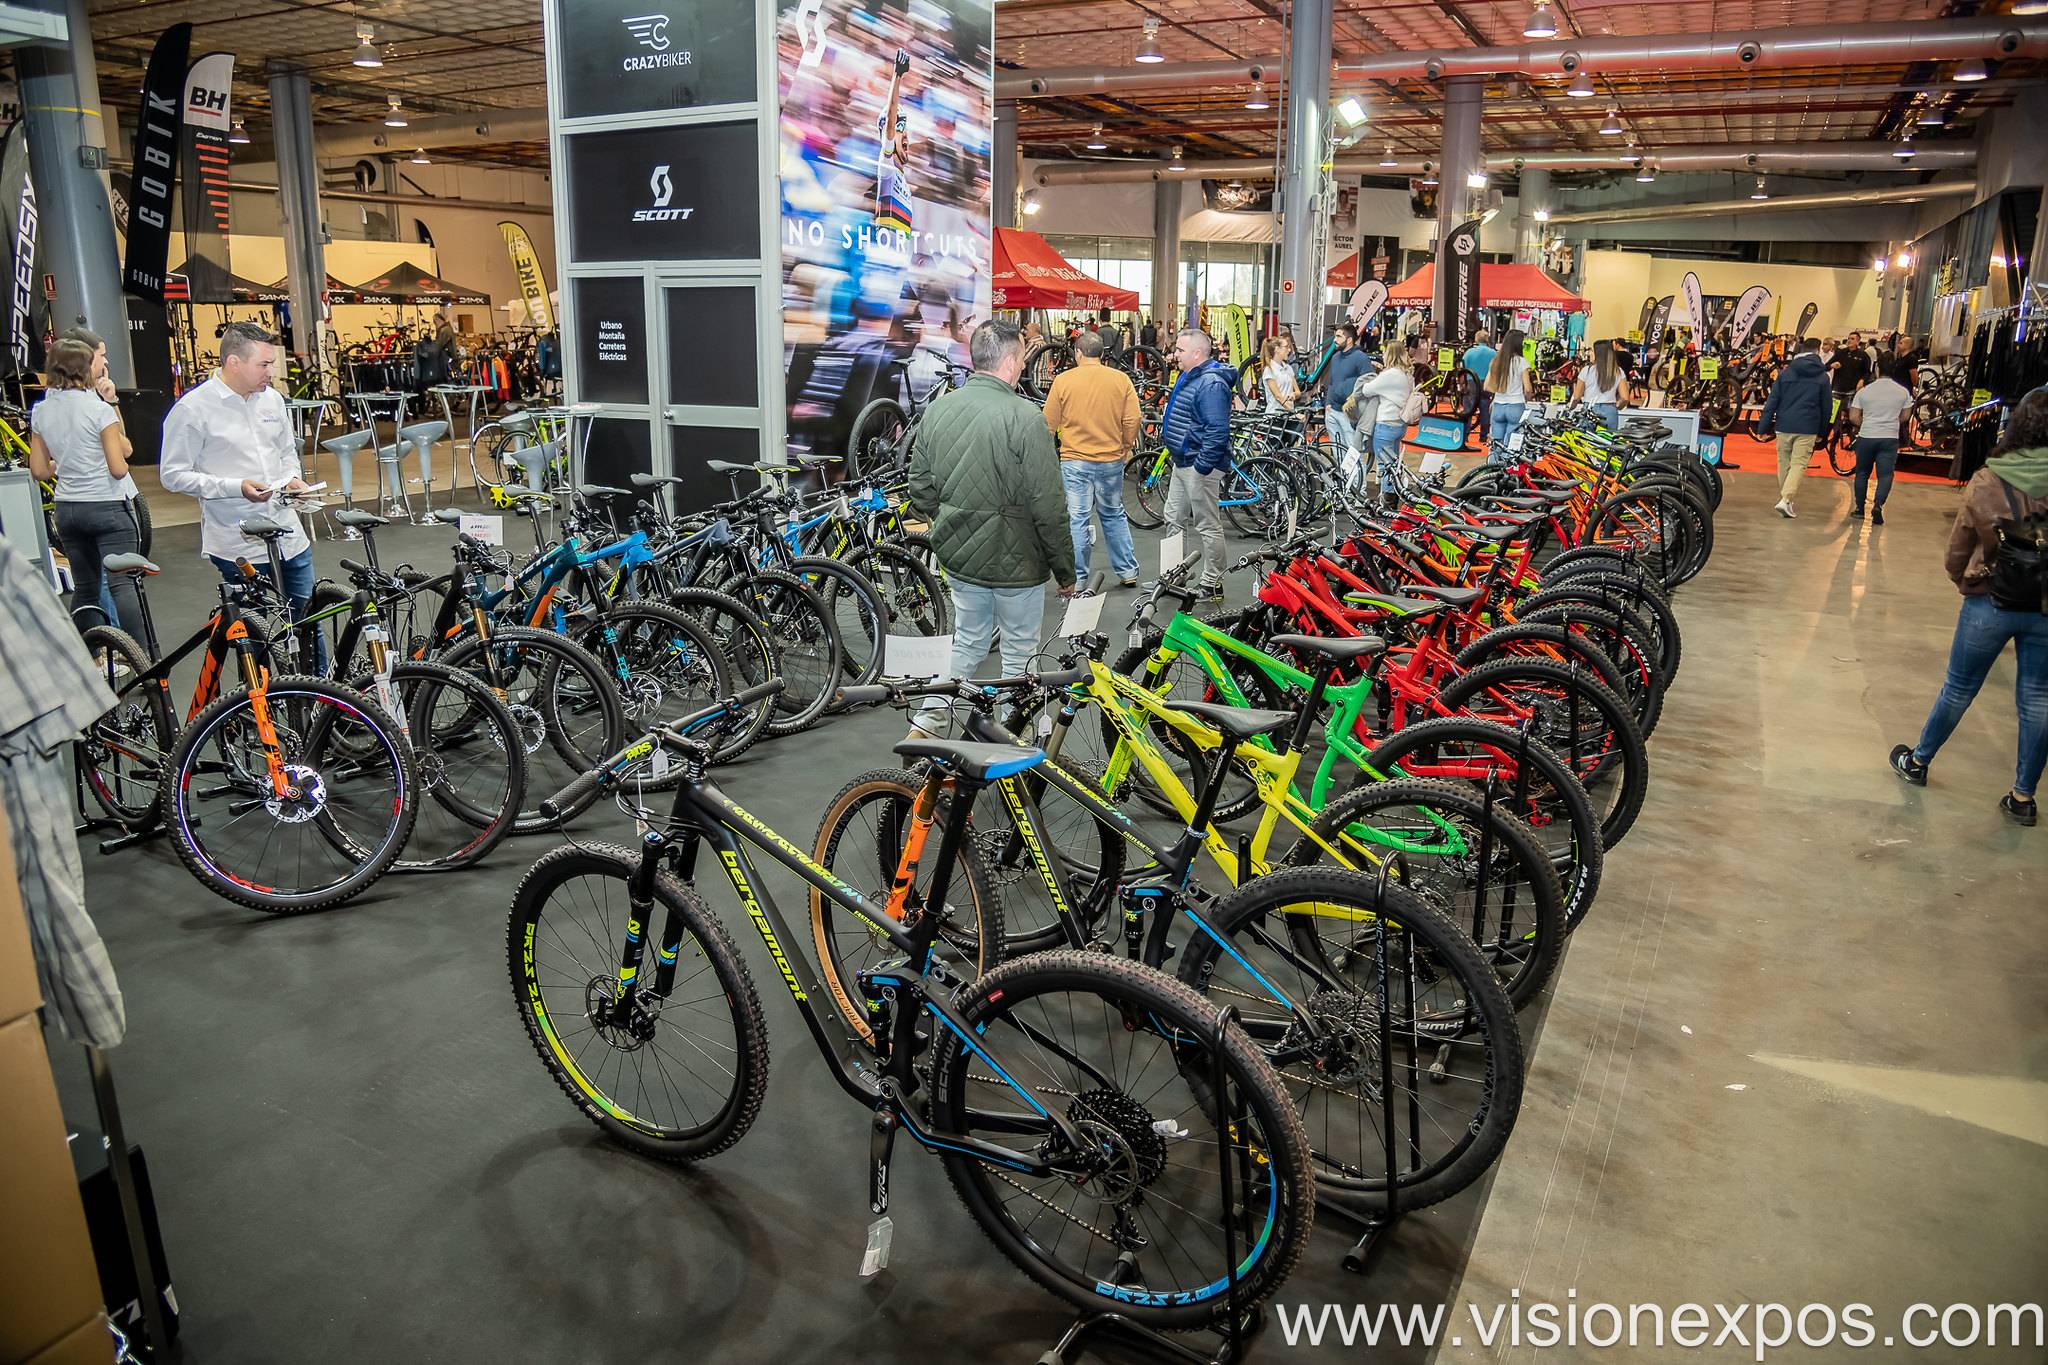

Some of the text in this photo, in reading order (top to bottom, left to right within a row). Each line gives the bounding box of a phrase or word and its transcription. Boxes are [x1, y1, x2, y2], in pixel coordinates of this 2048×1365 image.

[624, 51, 692, 71] CRAZYBIKER
[189, 86, 228, 111] BH
[138, 90, 177, 229] GOBIK
[632, 207, 694, 222] SCOTT
[788, 218, 978, 258] NO SHORTCUTS
[132, 268, 160, 291] GOBIK
[363, 296, 392, 304] 24MX
[415, 296, 442, 304] 24MX
[1355, 289, 1380, 324] CUBE
[598, 331, 626, 340] Montaña
[600, 320, 623, 330] Urbano
[1650, 317, 1665, 346] VOGE
[598, 342, 627, 351] Carretera
[599, 352, 628, 361] Eléctricas
[1001, 778, 1070, 913] bergamont
[721, 850, 808, 1002] bergamont
